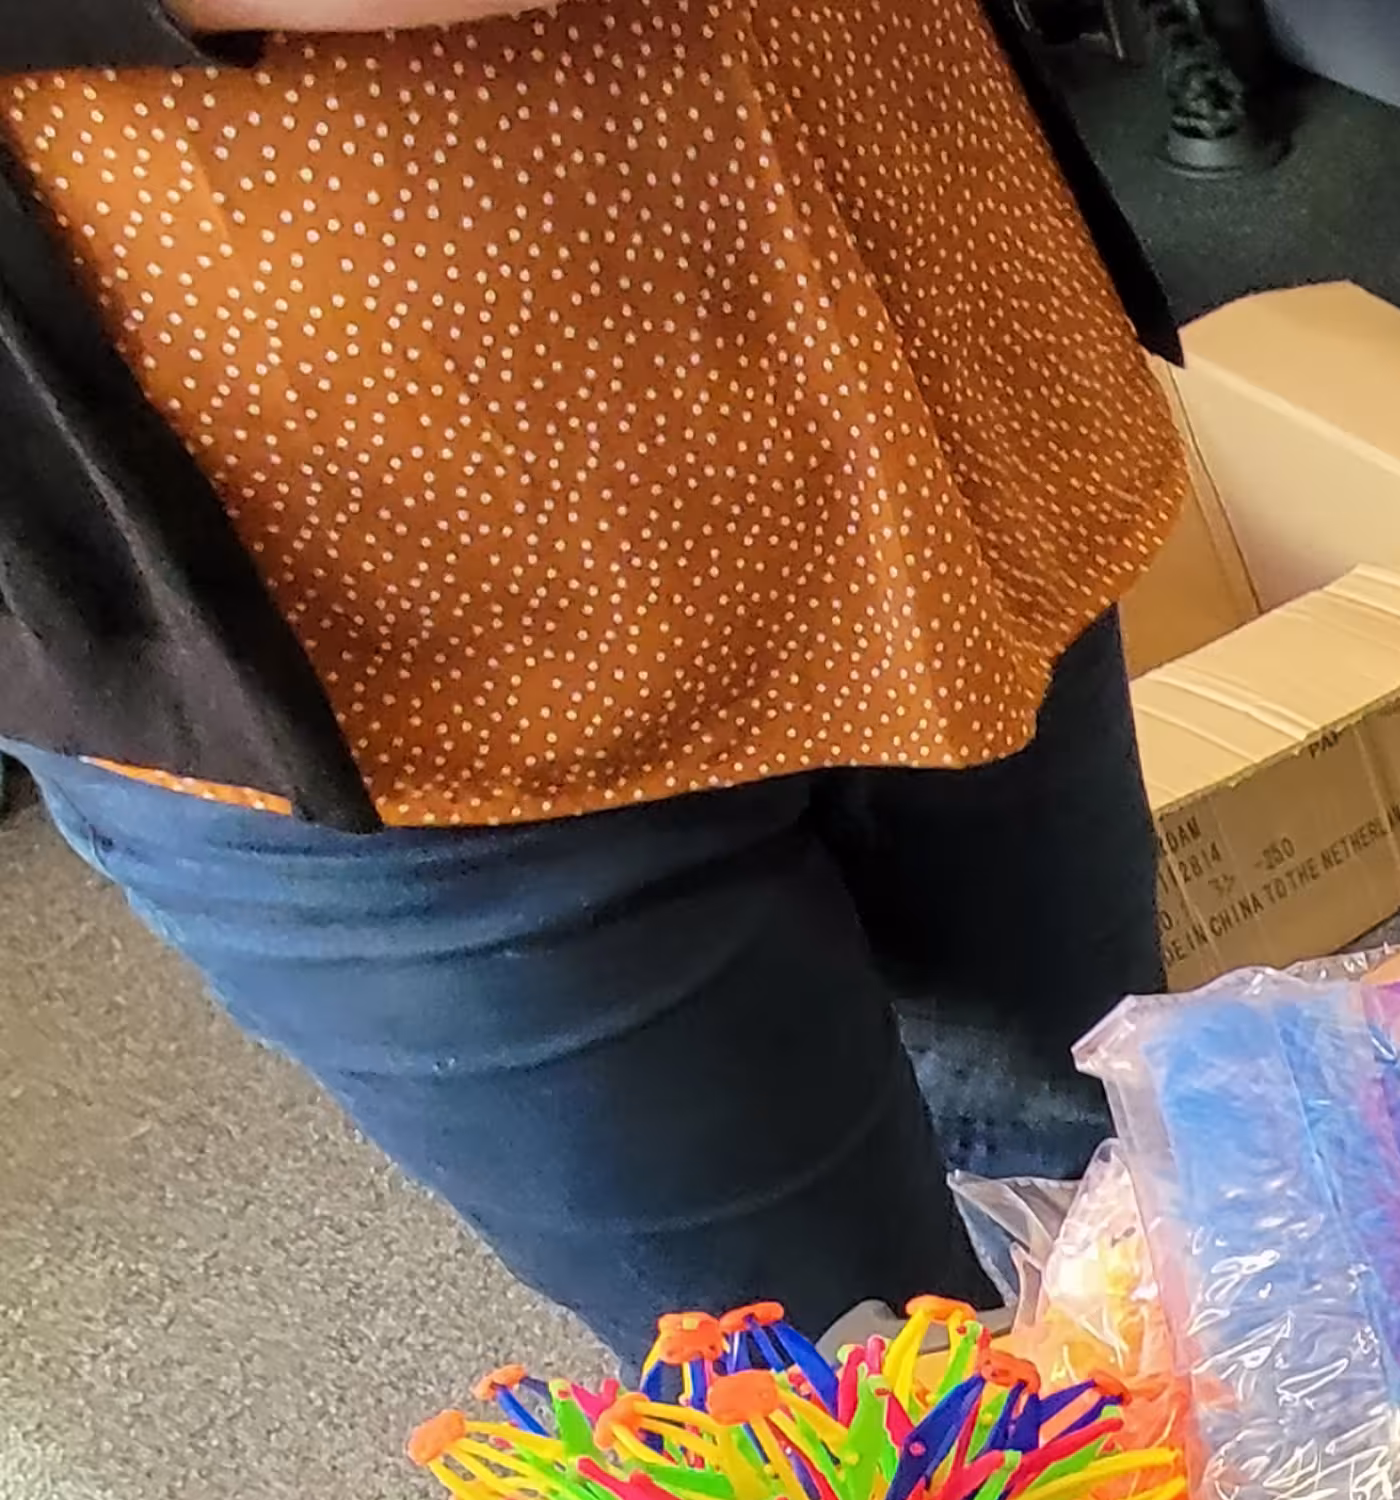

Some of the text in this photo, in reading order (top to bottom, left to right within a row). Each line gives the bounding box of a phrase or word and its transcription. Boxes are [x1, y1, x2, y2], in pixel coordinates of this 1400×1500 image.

[1187, 924, 1207, 953] IN
[1210, 895, 1263, 938] CHINA
[1264, 880, 1288, 908] TO
[1287, 861, 1320, 894] THE
